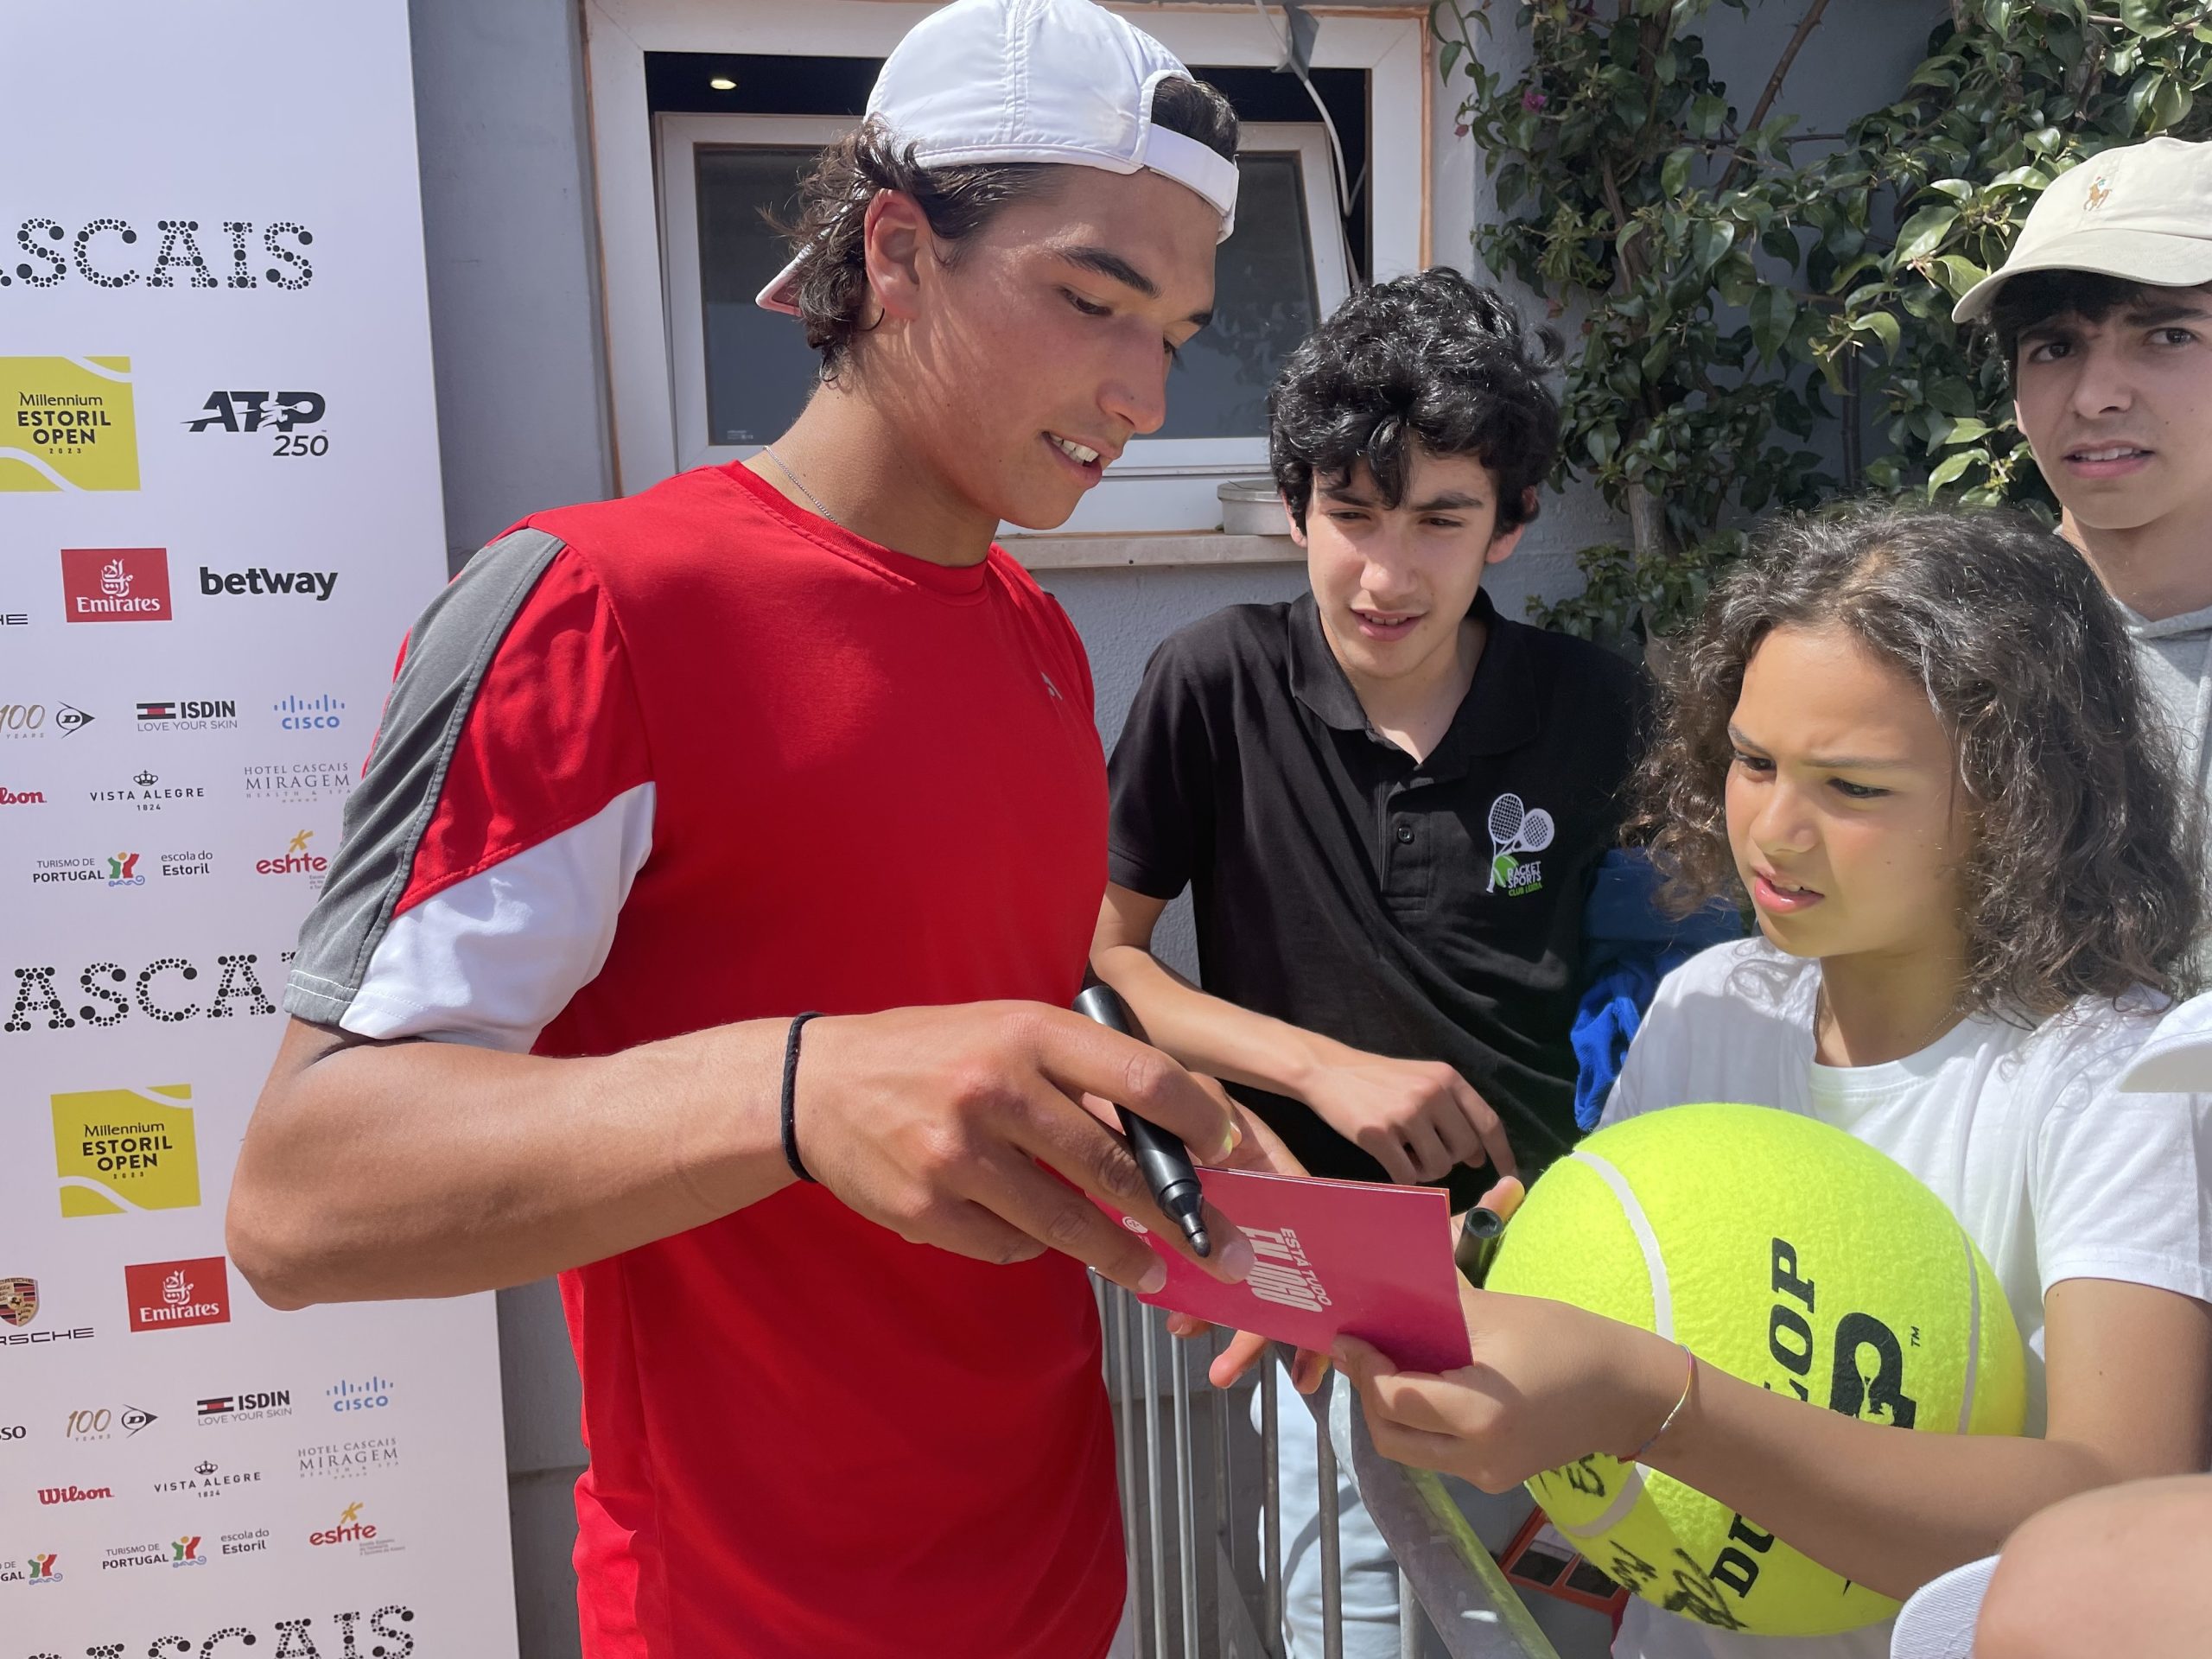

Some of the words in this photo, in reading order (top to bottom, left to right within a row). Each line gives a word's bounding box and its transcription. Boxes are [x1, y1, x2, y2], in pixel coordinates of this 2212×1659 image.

[0, 219, 313, 290] SCAIS
[19, 391, 103, 406] Millennium
[17, 410, 111, 426] ESTORIL
[180, 391, 326, 432] ATP
[33, 429, 96, 444] OPEN
[272, 435, 328, 456] 250
[200, 567, 338, 601] betway
[76, 595, 161, 613] Emirates
[0, 704, 45, 734] 100
[181, 701, 235, 719] ISDIN
[137, 721, 169, 732] LOVE
[173, 721, 207, 731] YOUR
[210, 720, 238, 729] SKIN
[245, 766, 287, 775] HOTEL
[293, 763, 348, 773] CASCAIS
[246, 774, 350, 790] MIRAGEM
[90, 791, 135, 801] VISTA
[143, 788, 204, 799] ALEGRE
[37, 859, 79, 868] TURISMO
[162, 851, 195, 861] escola
[198, 850, 213, 860] do
[256, 853, 327, 874] eshte
[33, 870, 105, 883] PORTUGAL
[163, 863, 209, 875] Estoril
[1508, 861, 1541, 877] RACKET
[1508, 874, 1541, 888] SPORTS
[4, 951, 296, 1032] ASCA
[84, 1122, 164, 1137] Millennium
[83, 1136, 173, 1156] ESTORIL
[98, 1154, 157, 1171] OPEN
[1281, 1228, 1312, 1267] ESTÁ
[1301, 1270, 1332, 1306] TUDO
[140, 1303, 219, 1322] Emirates
[238, 1390, 290, 1410] ISDIN
[67, 1408, 111, 1438] 100
[198, 1414, 228, 1426] LOVE
[232, 1411, 264, 1423] YOUR
[267, 1408, 292, 1418] SKIN
[298, 1445, 338, 1457] HOTEL
[344, 1437, 396, 1451] CASCAIS
[300, 1447, 397, 1471] MIRAGEM
[154, 1480, 196, 1492] VISTA
[204, 1472, 261, 1487] ALEGRE
[37, 1485, 113, 1505] Wilson
[221, 1530, 253, 1541] escola
[255, 1529, 270, 1537] do
[309, 1522, 377, 1545] eshte
[106, 1545, 146, 1556] TURISMO
[222, 1540, 266, 1554] Estoril
[103, 1554, 168, 1569] PORTUGAL
